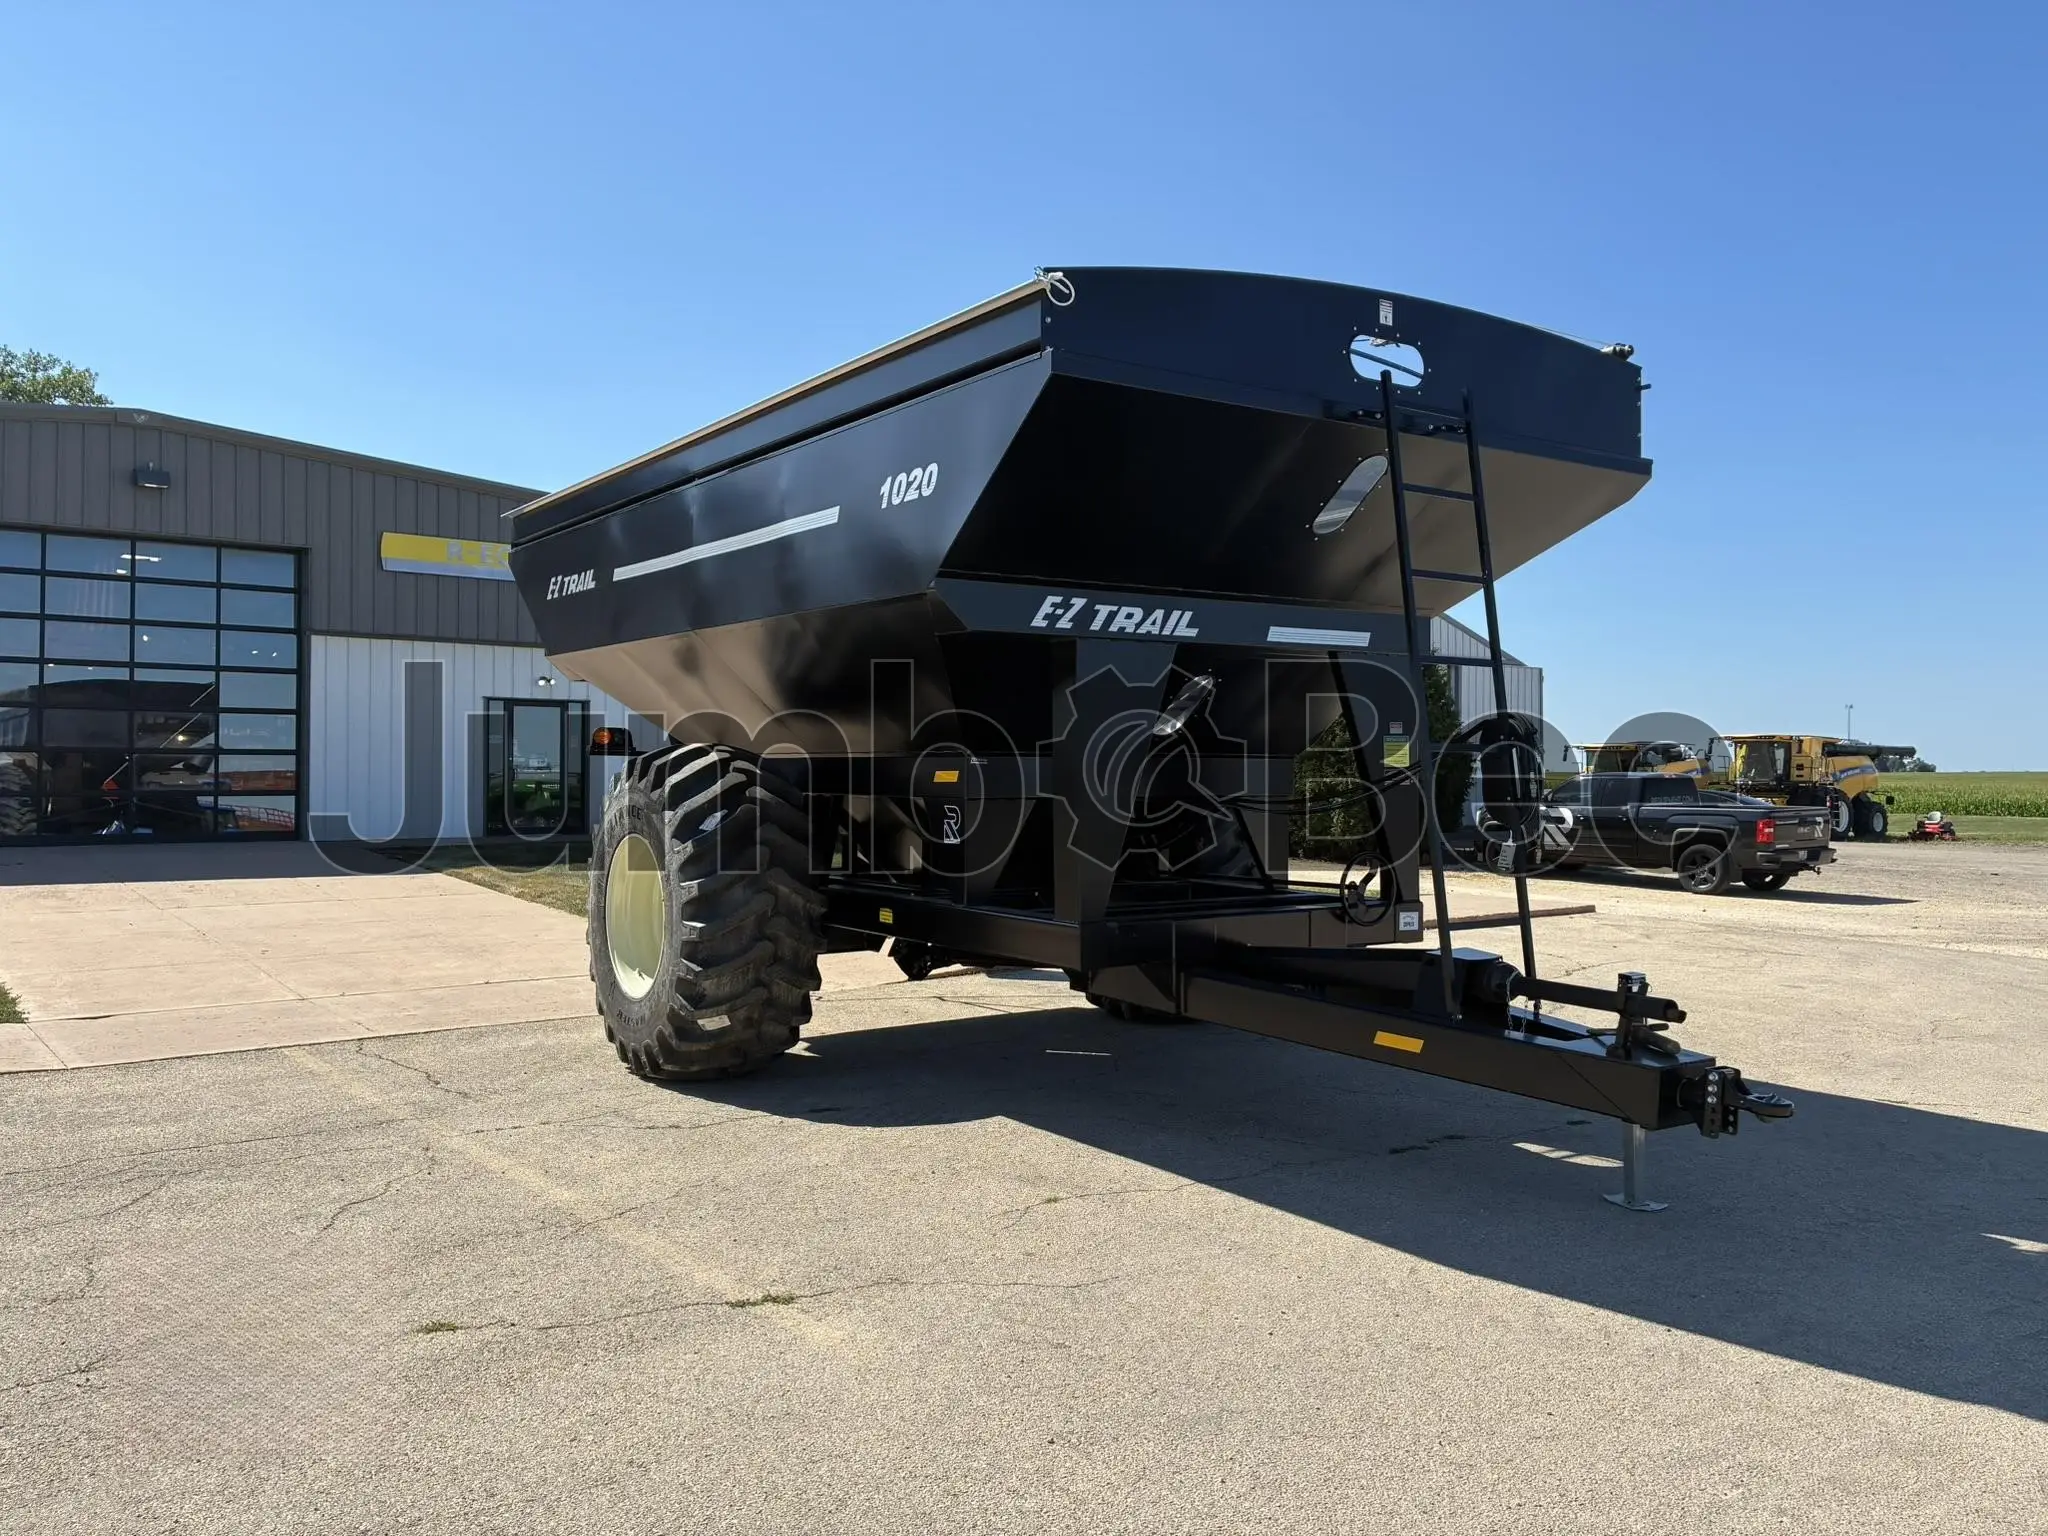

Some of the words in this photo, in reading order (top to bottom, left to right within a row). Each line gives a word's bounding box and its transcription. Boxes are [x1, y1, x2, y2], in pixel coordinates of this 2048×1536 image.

[880, 462, 939, 509] 1020
[563, 569, 596, 596] TRAIL
[1030, 595, 1088, 629] E-Z
[1089, 604, 1200, 637] TRAIL
